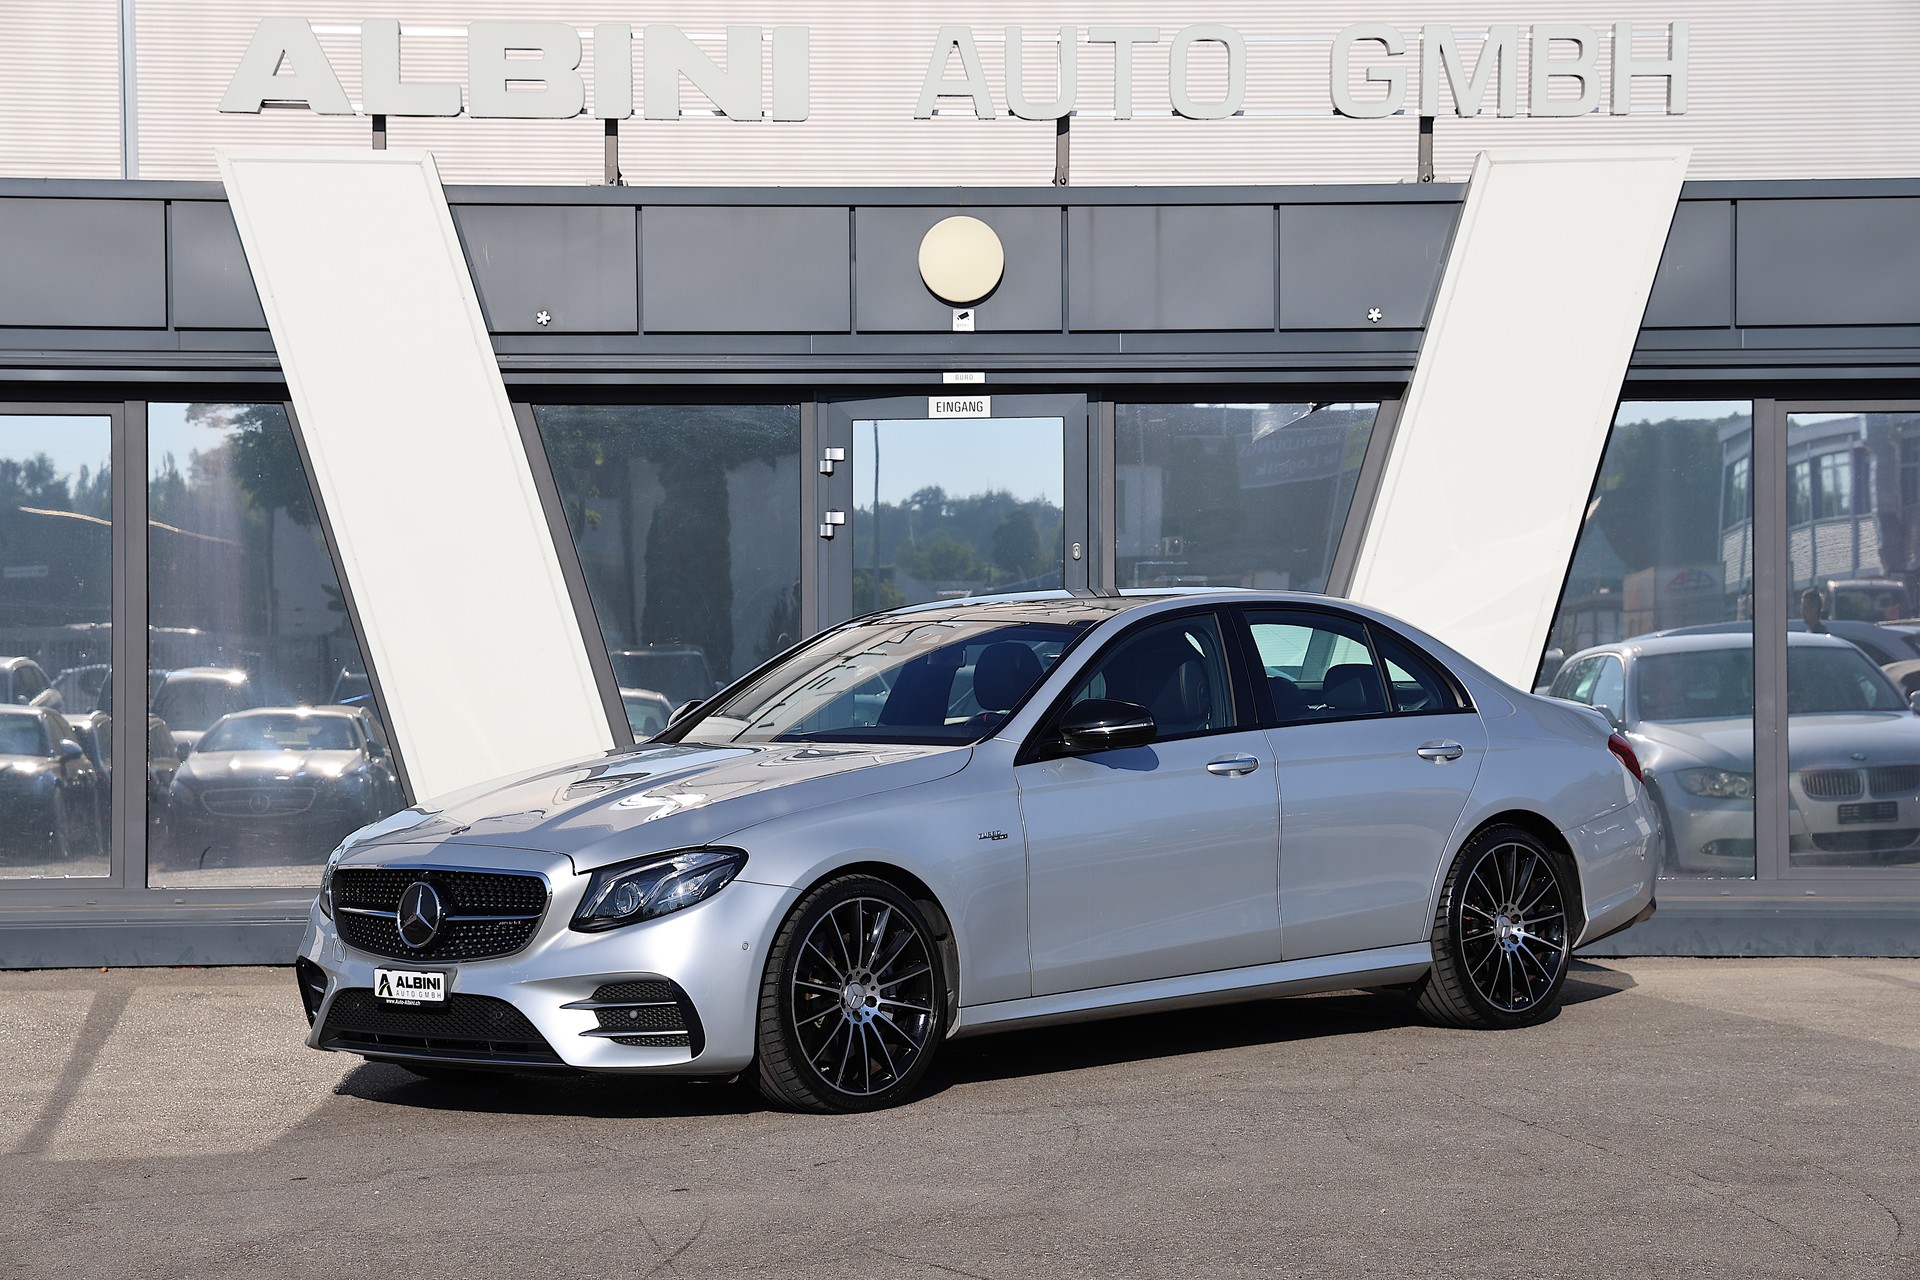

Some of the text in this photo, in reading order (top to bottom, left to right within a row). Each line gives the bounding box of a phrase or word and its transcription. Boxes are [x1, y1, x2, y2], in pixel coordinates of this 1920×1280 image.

[218, 17, 1690, 122] ALBINI AUTO GMBH
[936, 401, 984, 413] EINGANG
[396, 976, 441, 990] ALBINI
